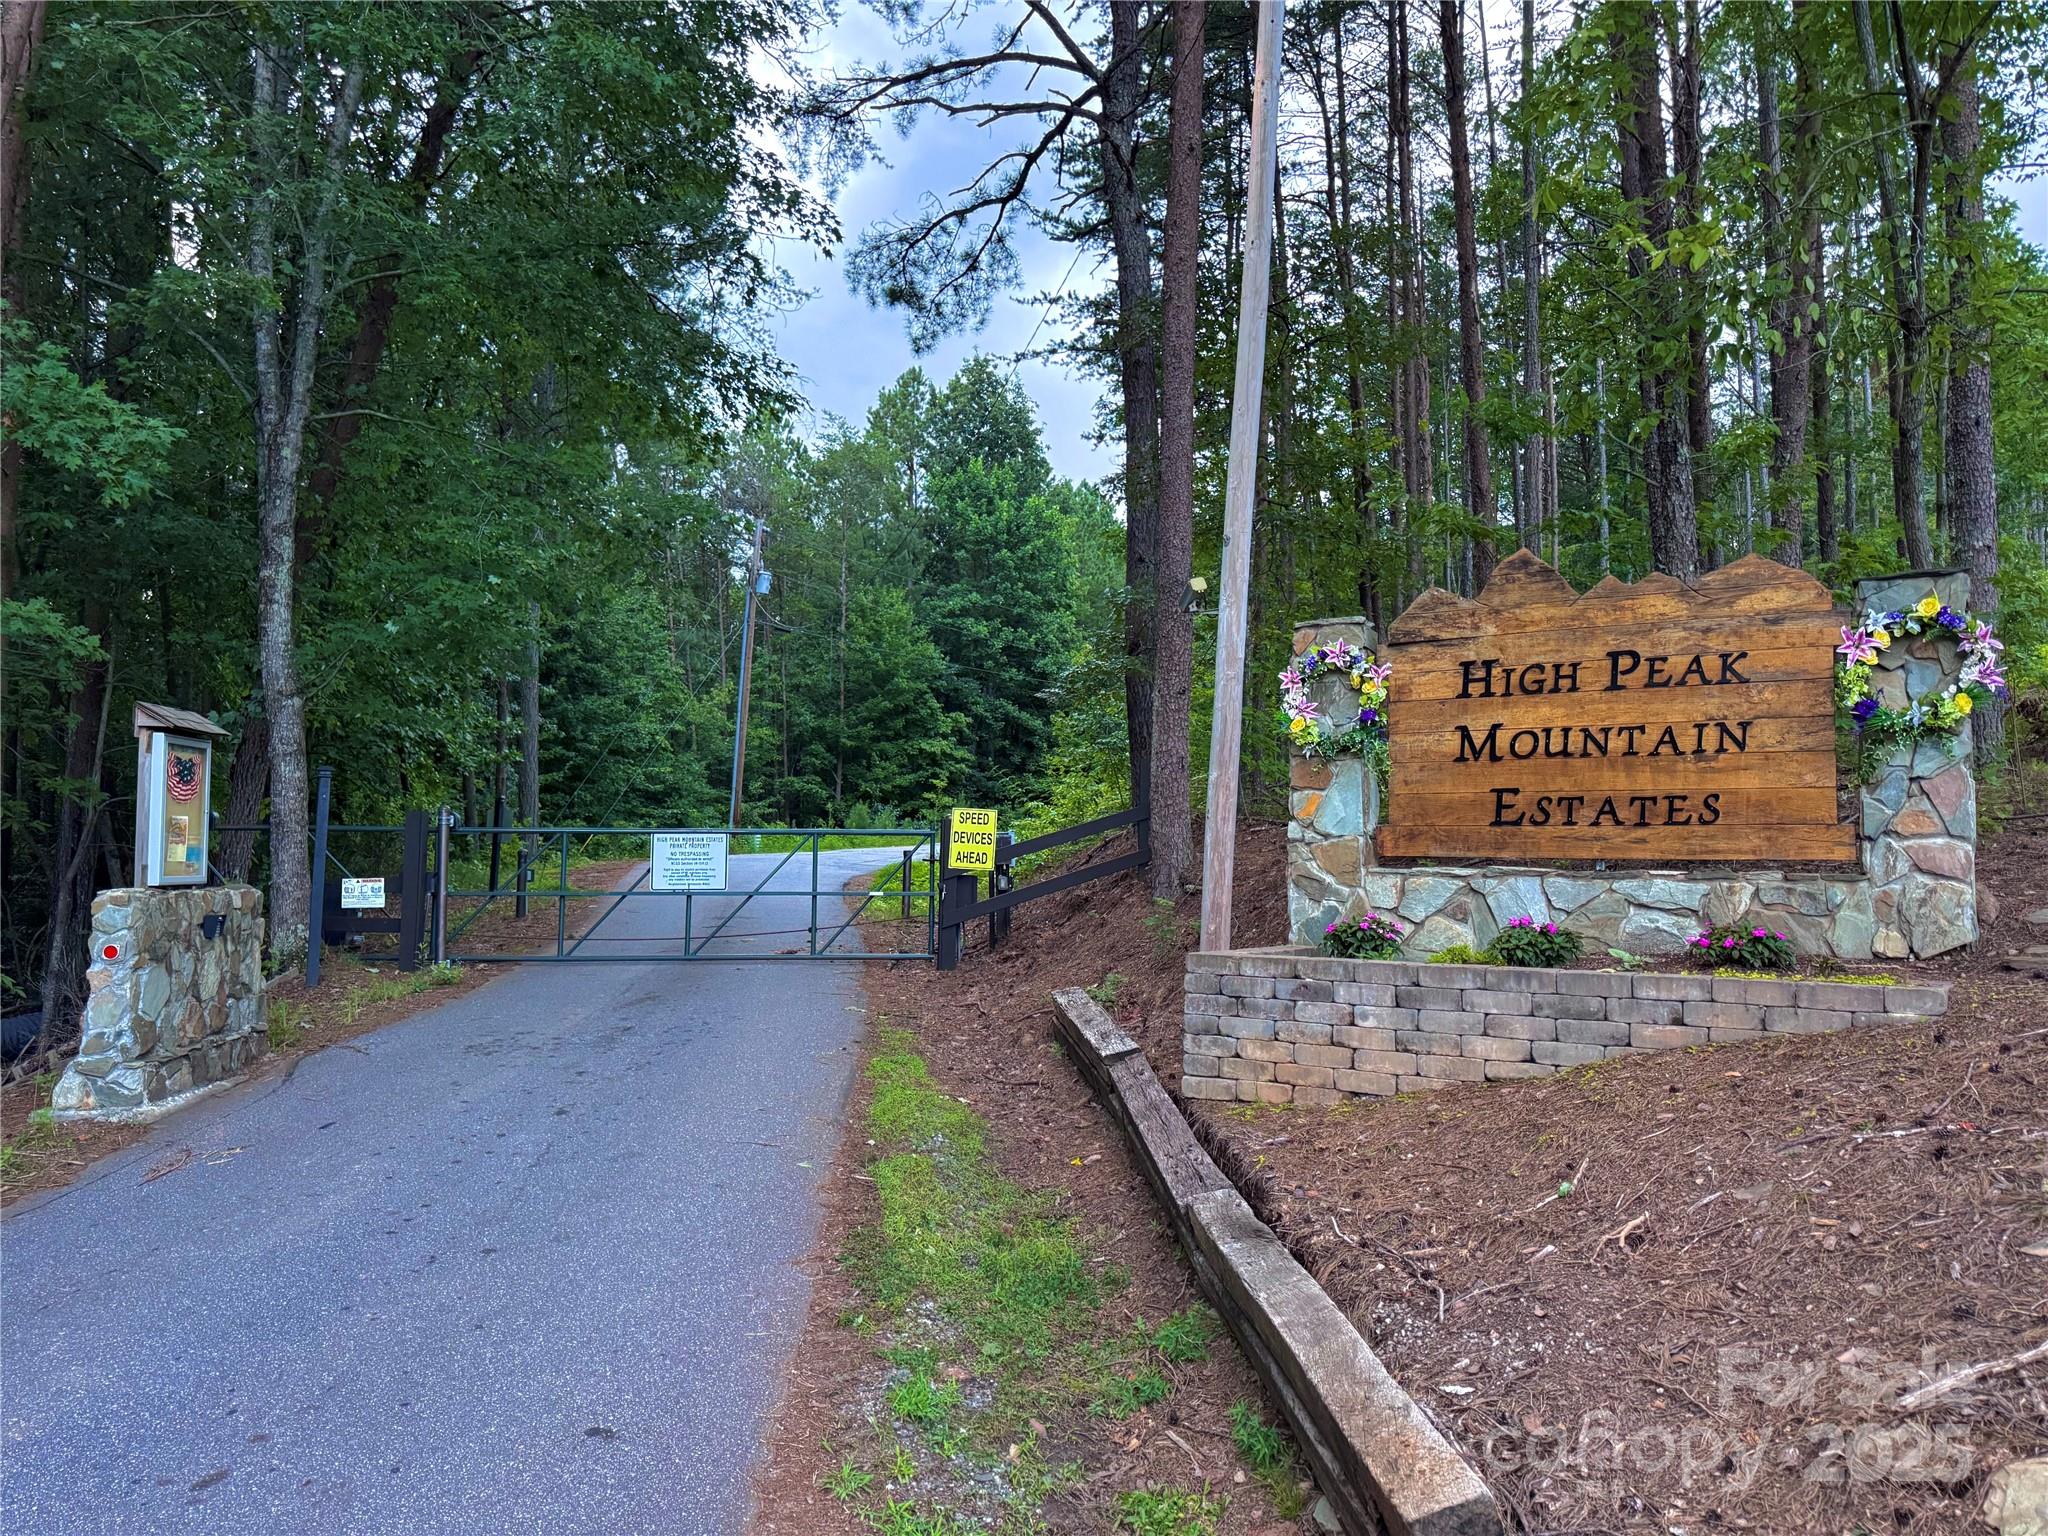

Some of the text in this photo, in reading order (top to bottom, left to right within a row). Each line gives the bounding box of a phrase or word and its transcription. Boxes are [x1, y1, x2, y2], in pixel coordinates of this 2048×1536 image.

[958, 811, 990, 825] SPEED
[953, 831, 993, 845] DEVICES
[955, 851, 988, 864] AHEAD
